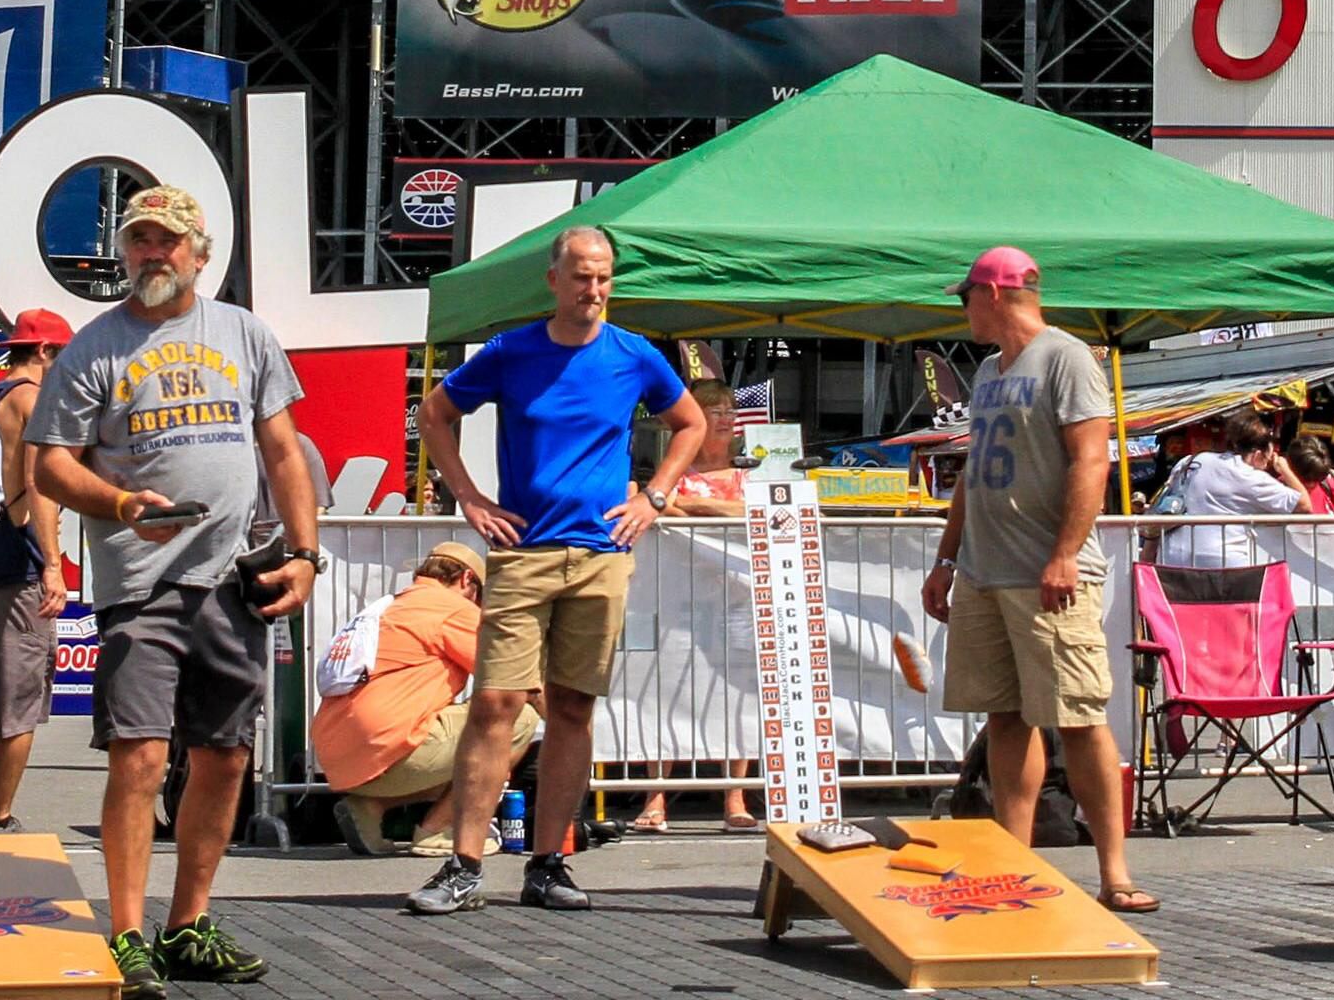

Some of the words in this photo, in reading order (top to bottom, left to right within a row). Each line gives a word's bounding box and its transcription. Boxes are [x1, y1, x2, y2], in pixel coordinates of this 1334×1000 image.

[442, 82, 584, 98] BassPro.com
[114, 341, 239, 404] CAROLINA
[158, 366, 207, 401] NSA
[129, 403, 237, 434] SOFTBALL
[129, 434, 196, 455] TOURNAMENT
[774, 486, 786, 502] 8
